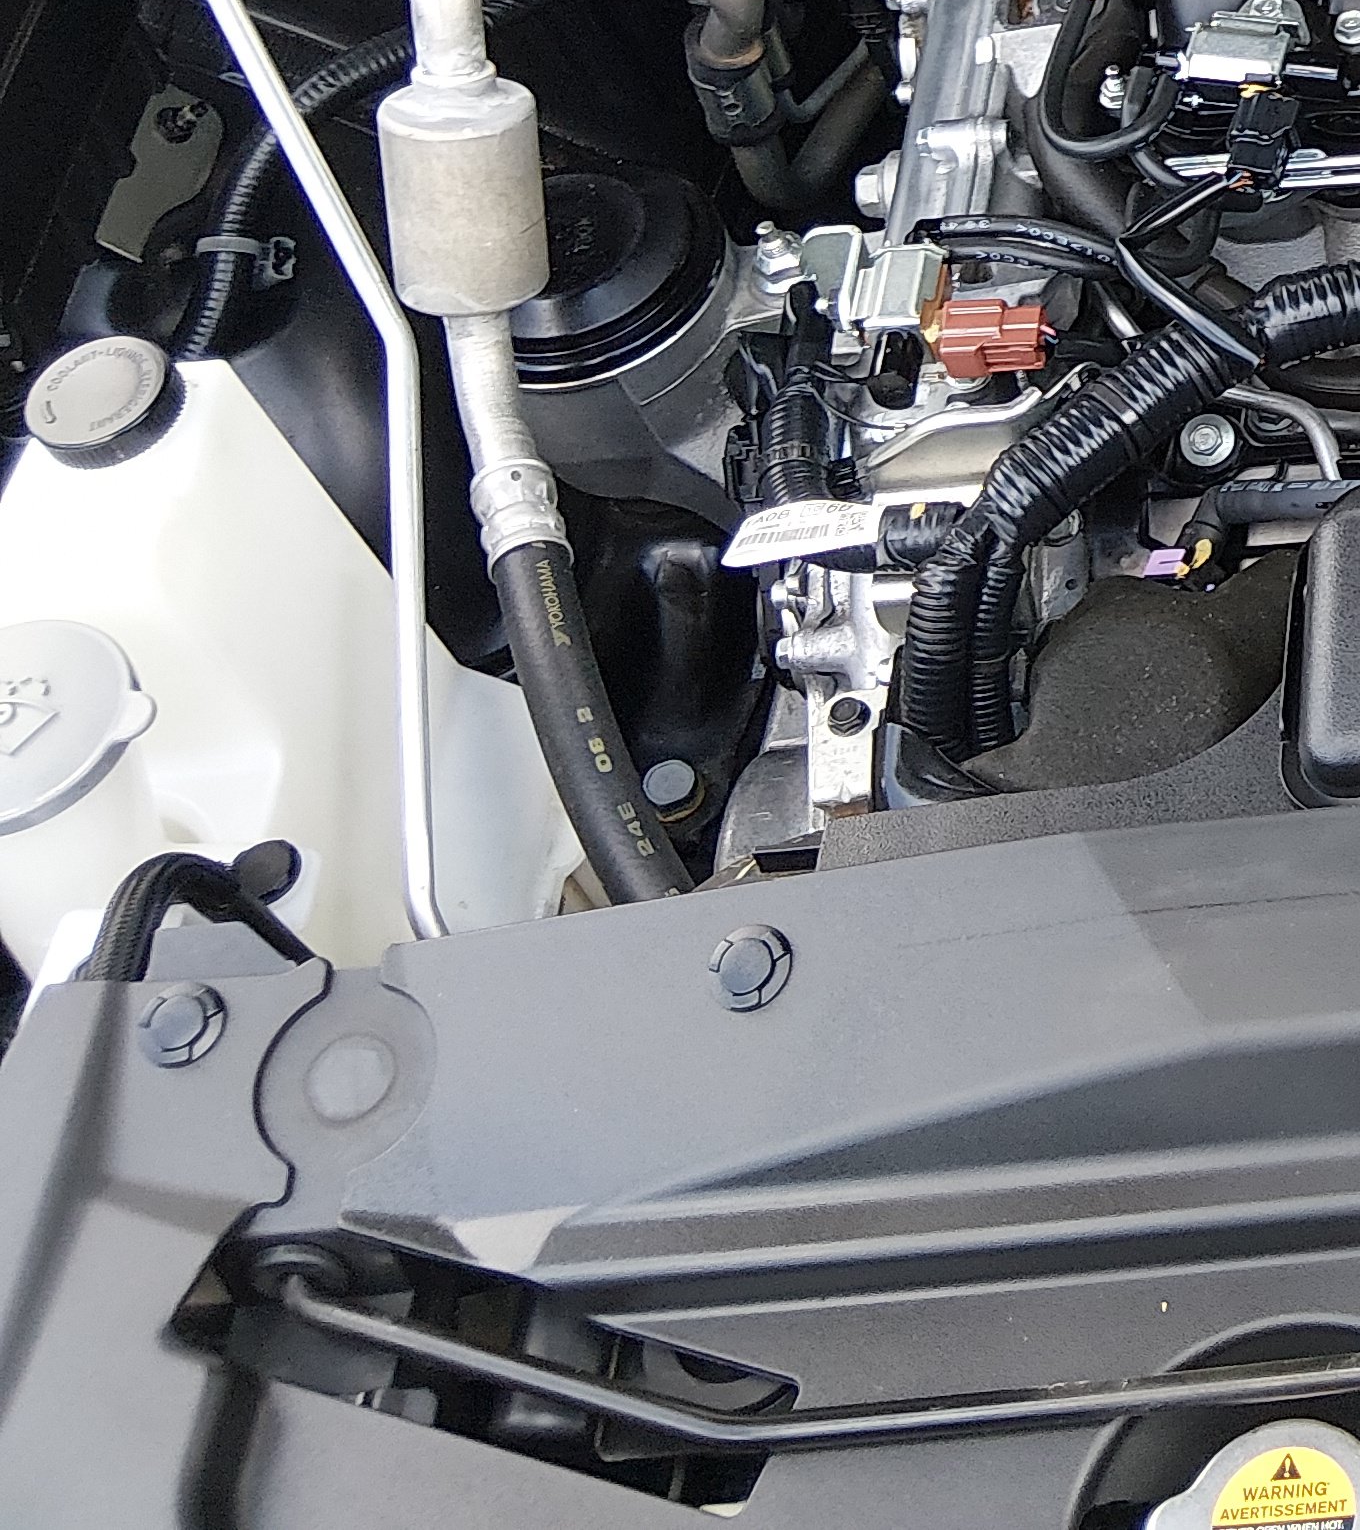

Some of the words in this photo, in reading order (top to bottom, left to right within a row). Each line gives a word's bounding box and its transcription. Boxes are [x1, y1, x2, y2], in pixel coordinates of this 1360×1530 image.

[538, 558, 566, 632] YOKOHAMA
[1243, 1481, 1328, 1503] WARNING
[1220, 1499, 1348, 1521] AVERTISSEMENT
